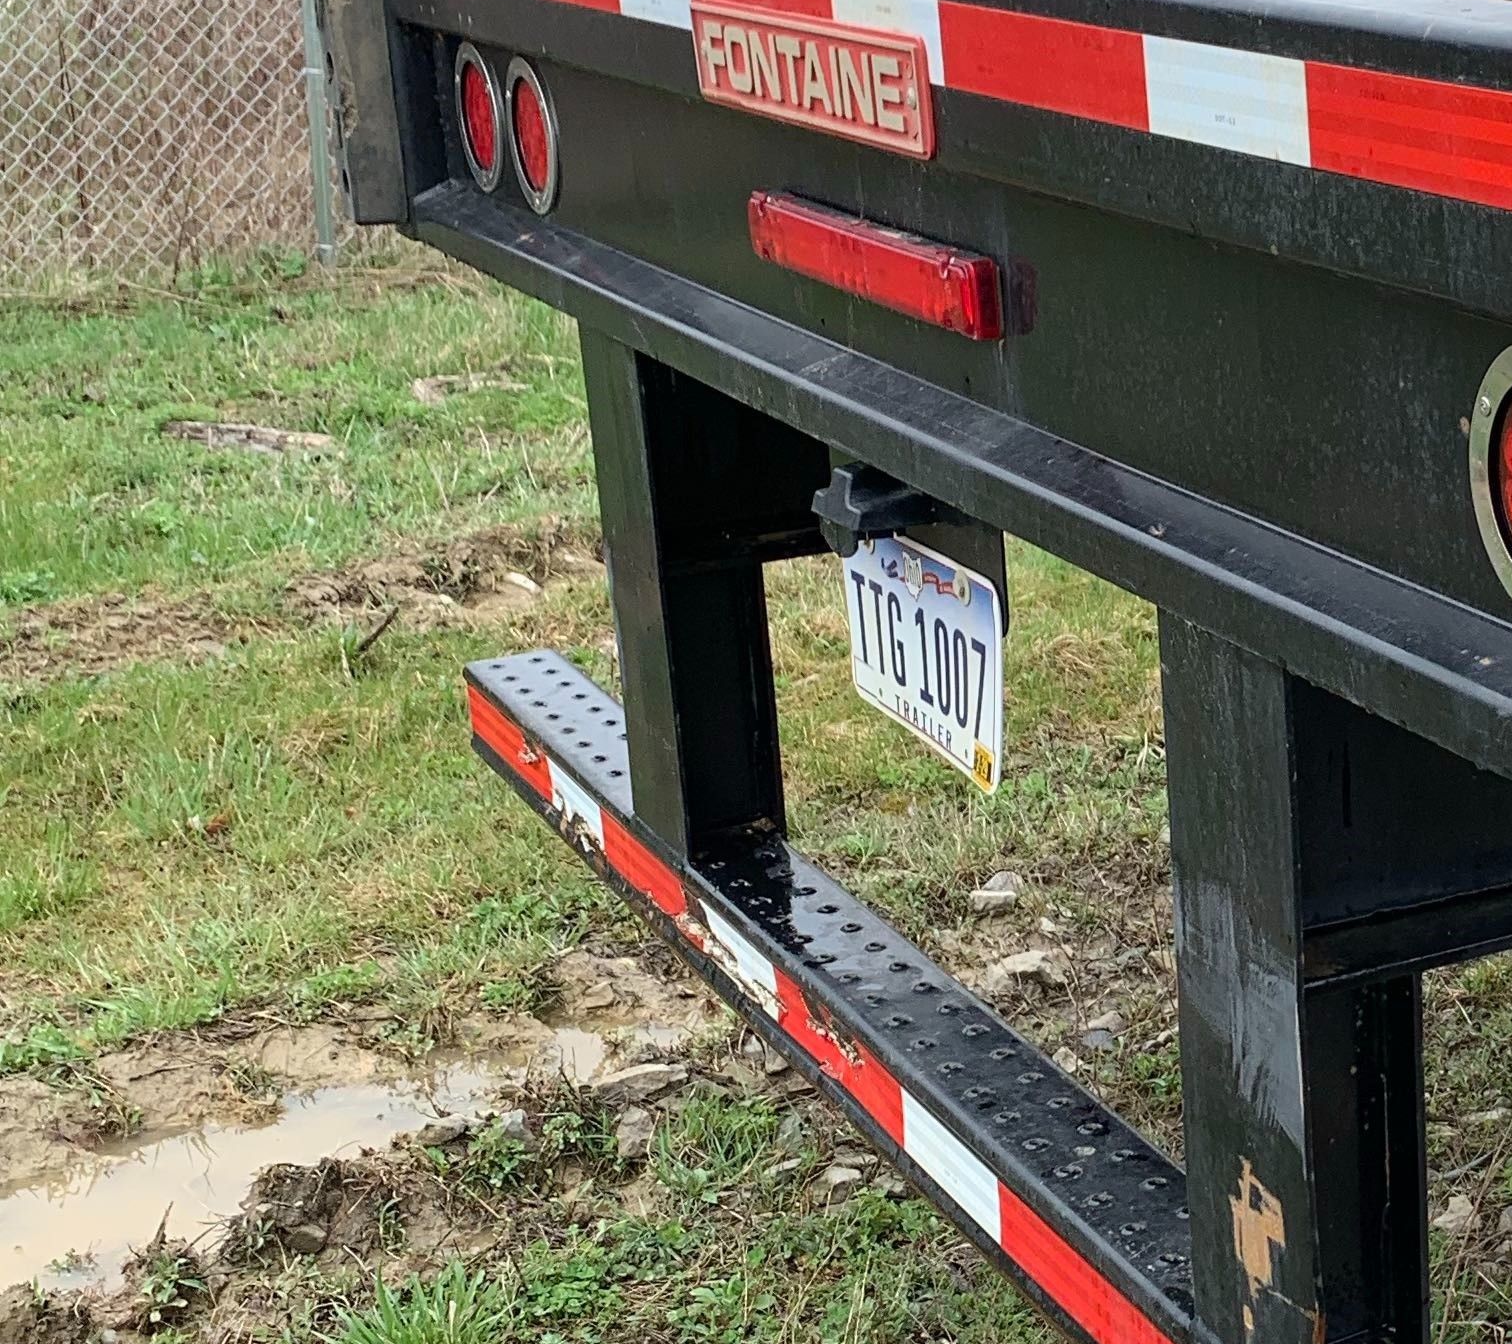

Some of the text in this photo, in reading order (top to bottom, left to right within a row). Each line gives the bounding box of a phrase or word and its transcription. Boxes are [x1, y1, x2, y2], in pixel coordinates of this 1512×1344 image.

[701, 19, 906, 134] FONTAINE
[851, 570, 986, 740] TTG 1007
[895, 694, 952, 752] TRAILER
